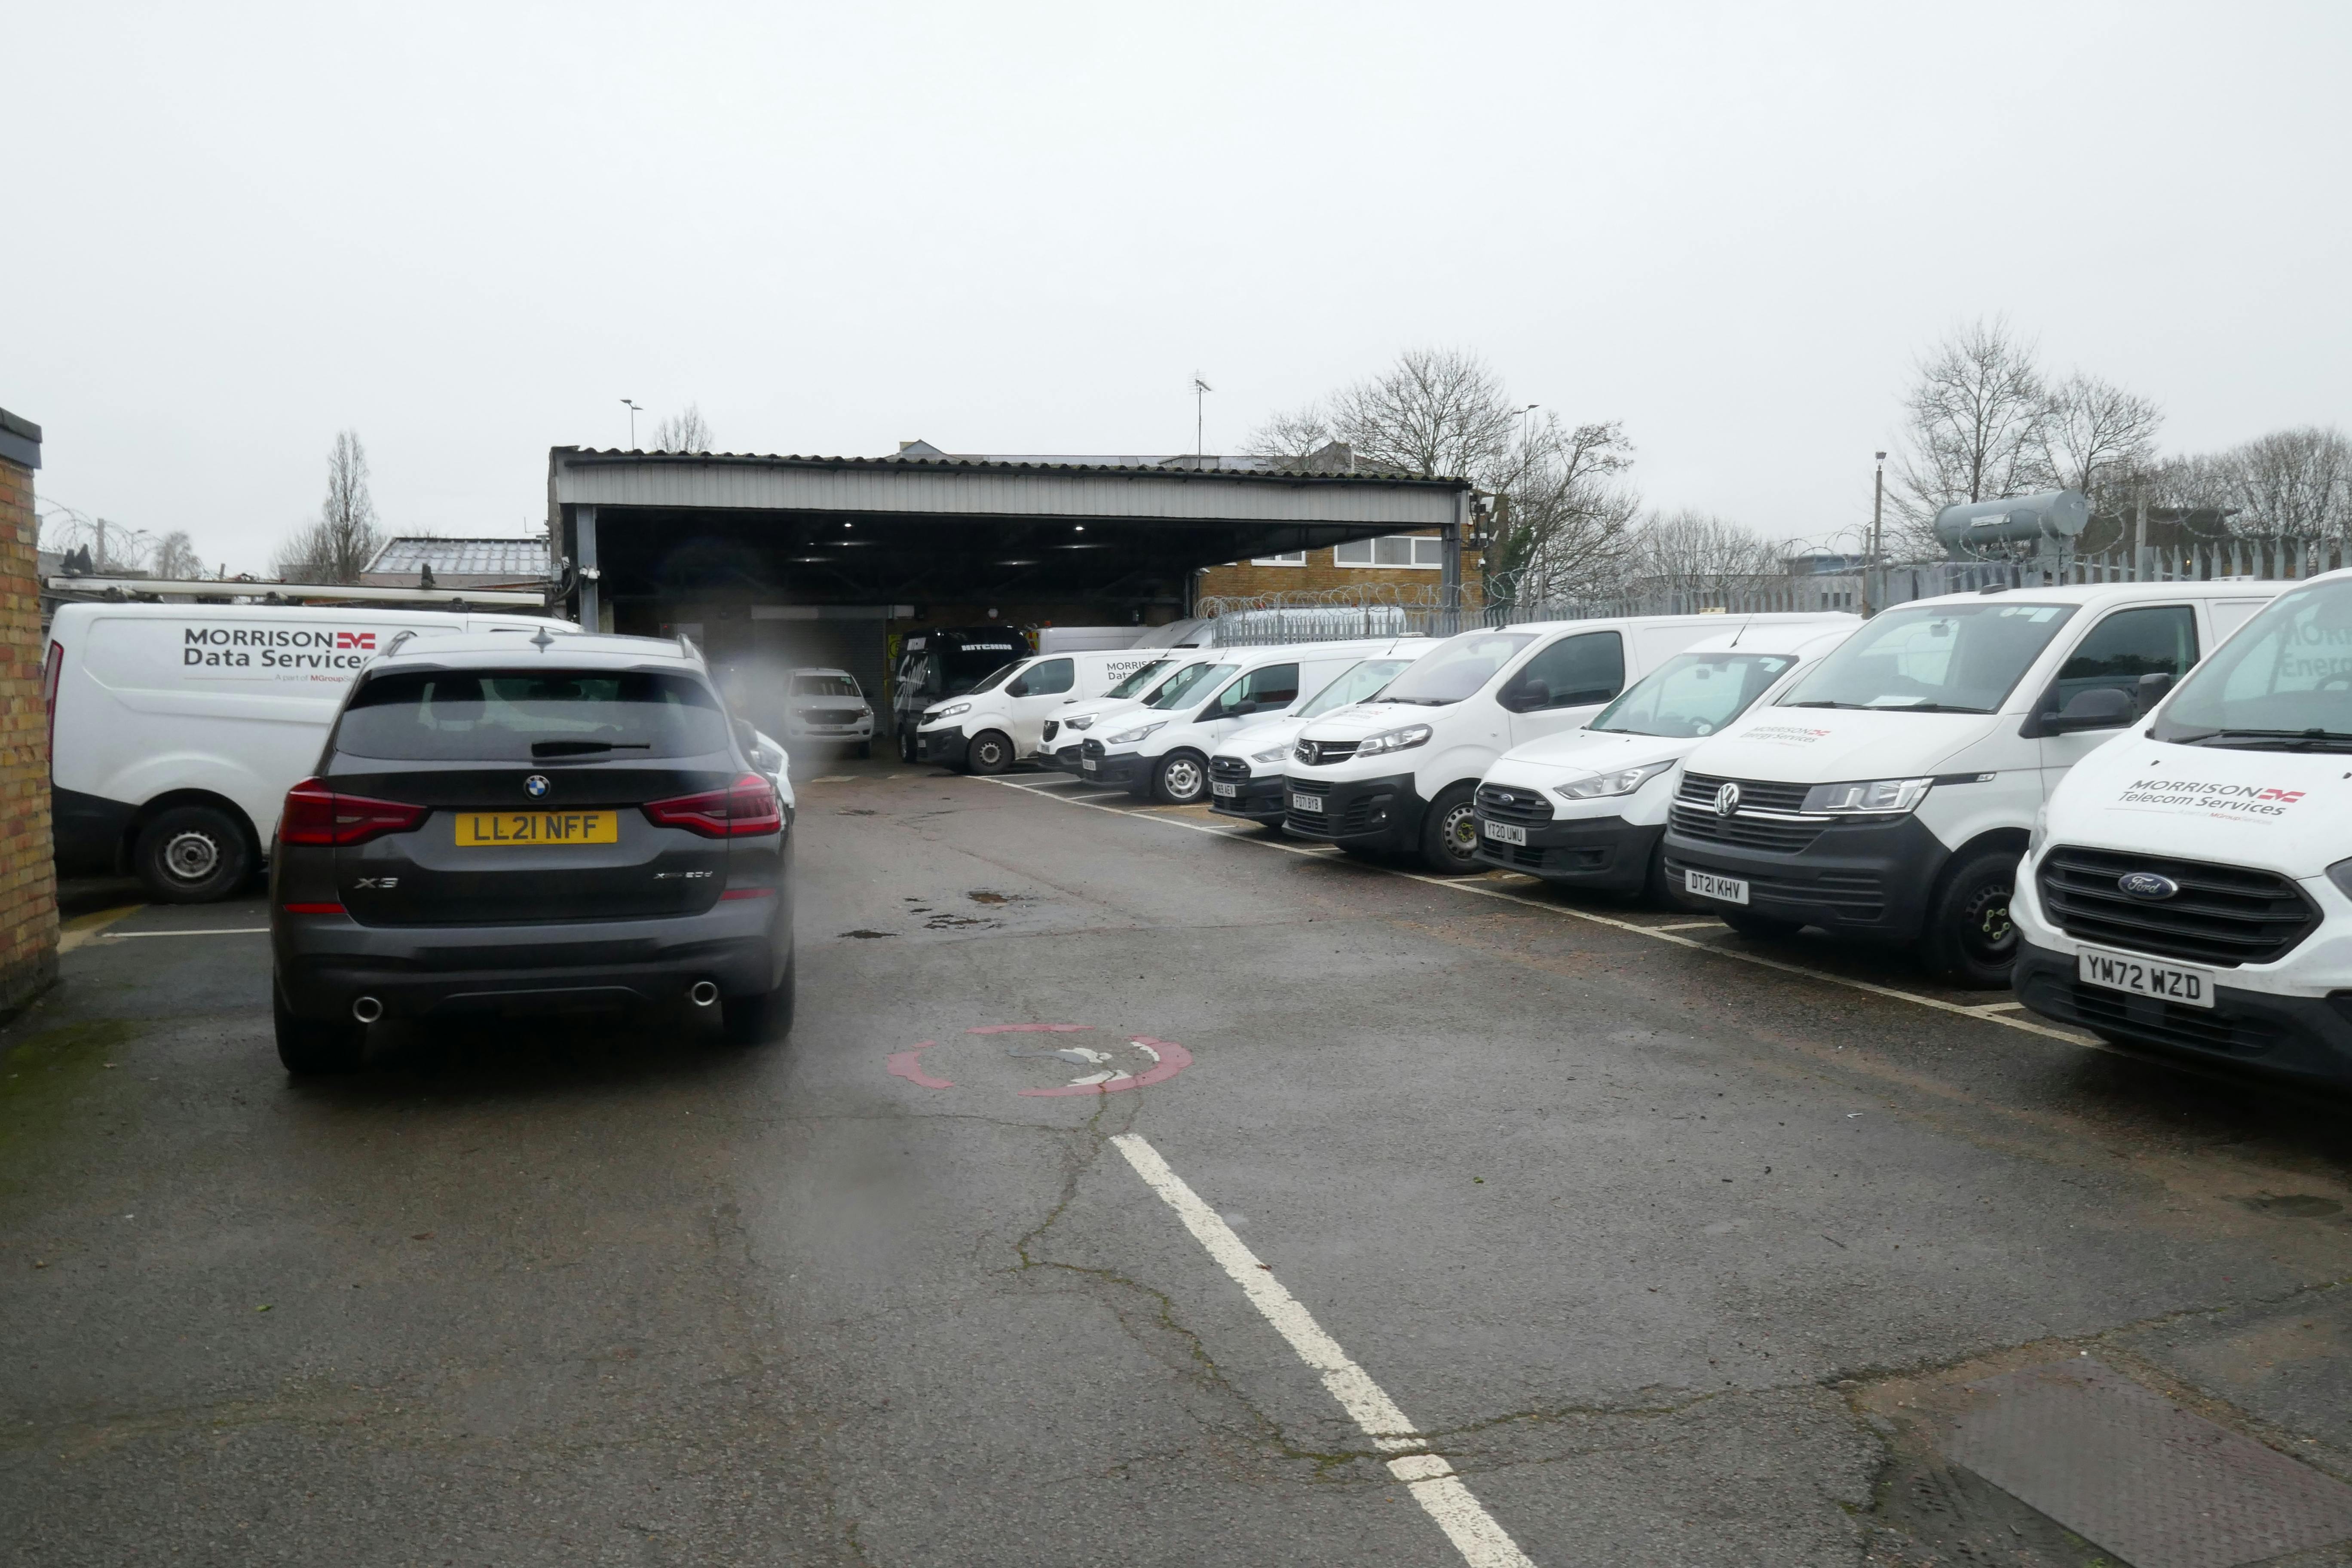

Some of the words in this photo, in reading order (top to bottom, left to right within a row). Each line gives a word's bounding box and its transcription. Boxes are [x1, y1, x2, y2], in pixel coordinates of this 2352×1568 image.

[184, 628, 333, 647] MORRISON
[184, 648, 250, 667] Data
[1106, 661, 1152, 671] MORRIS
[1773, 733, 1819, 743] Services
[2128, 780, 2264, 797] MORRISON
[2118, 790, 2194, 805] Telecom
[2195, 796, 2287, 816] Services
[474, 816, 536, 841] LL21
[545, 814, 599, 839] NFF
[1487, 822, 1505, 838] YT20
[353, 877, 399, 889] X3
[1692, 873, 1714, 894] DT21
[1718, 879, 1740, 899] KHV
[2128, 876, 2161, 894] Ford
[2088, 955, 2144, 989] YM72
[2150, 968, 2200, 1000] WZD
